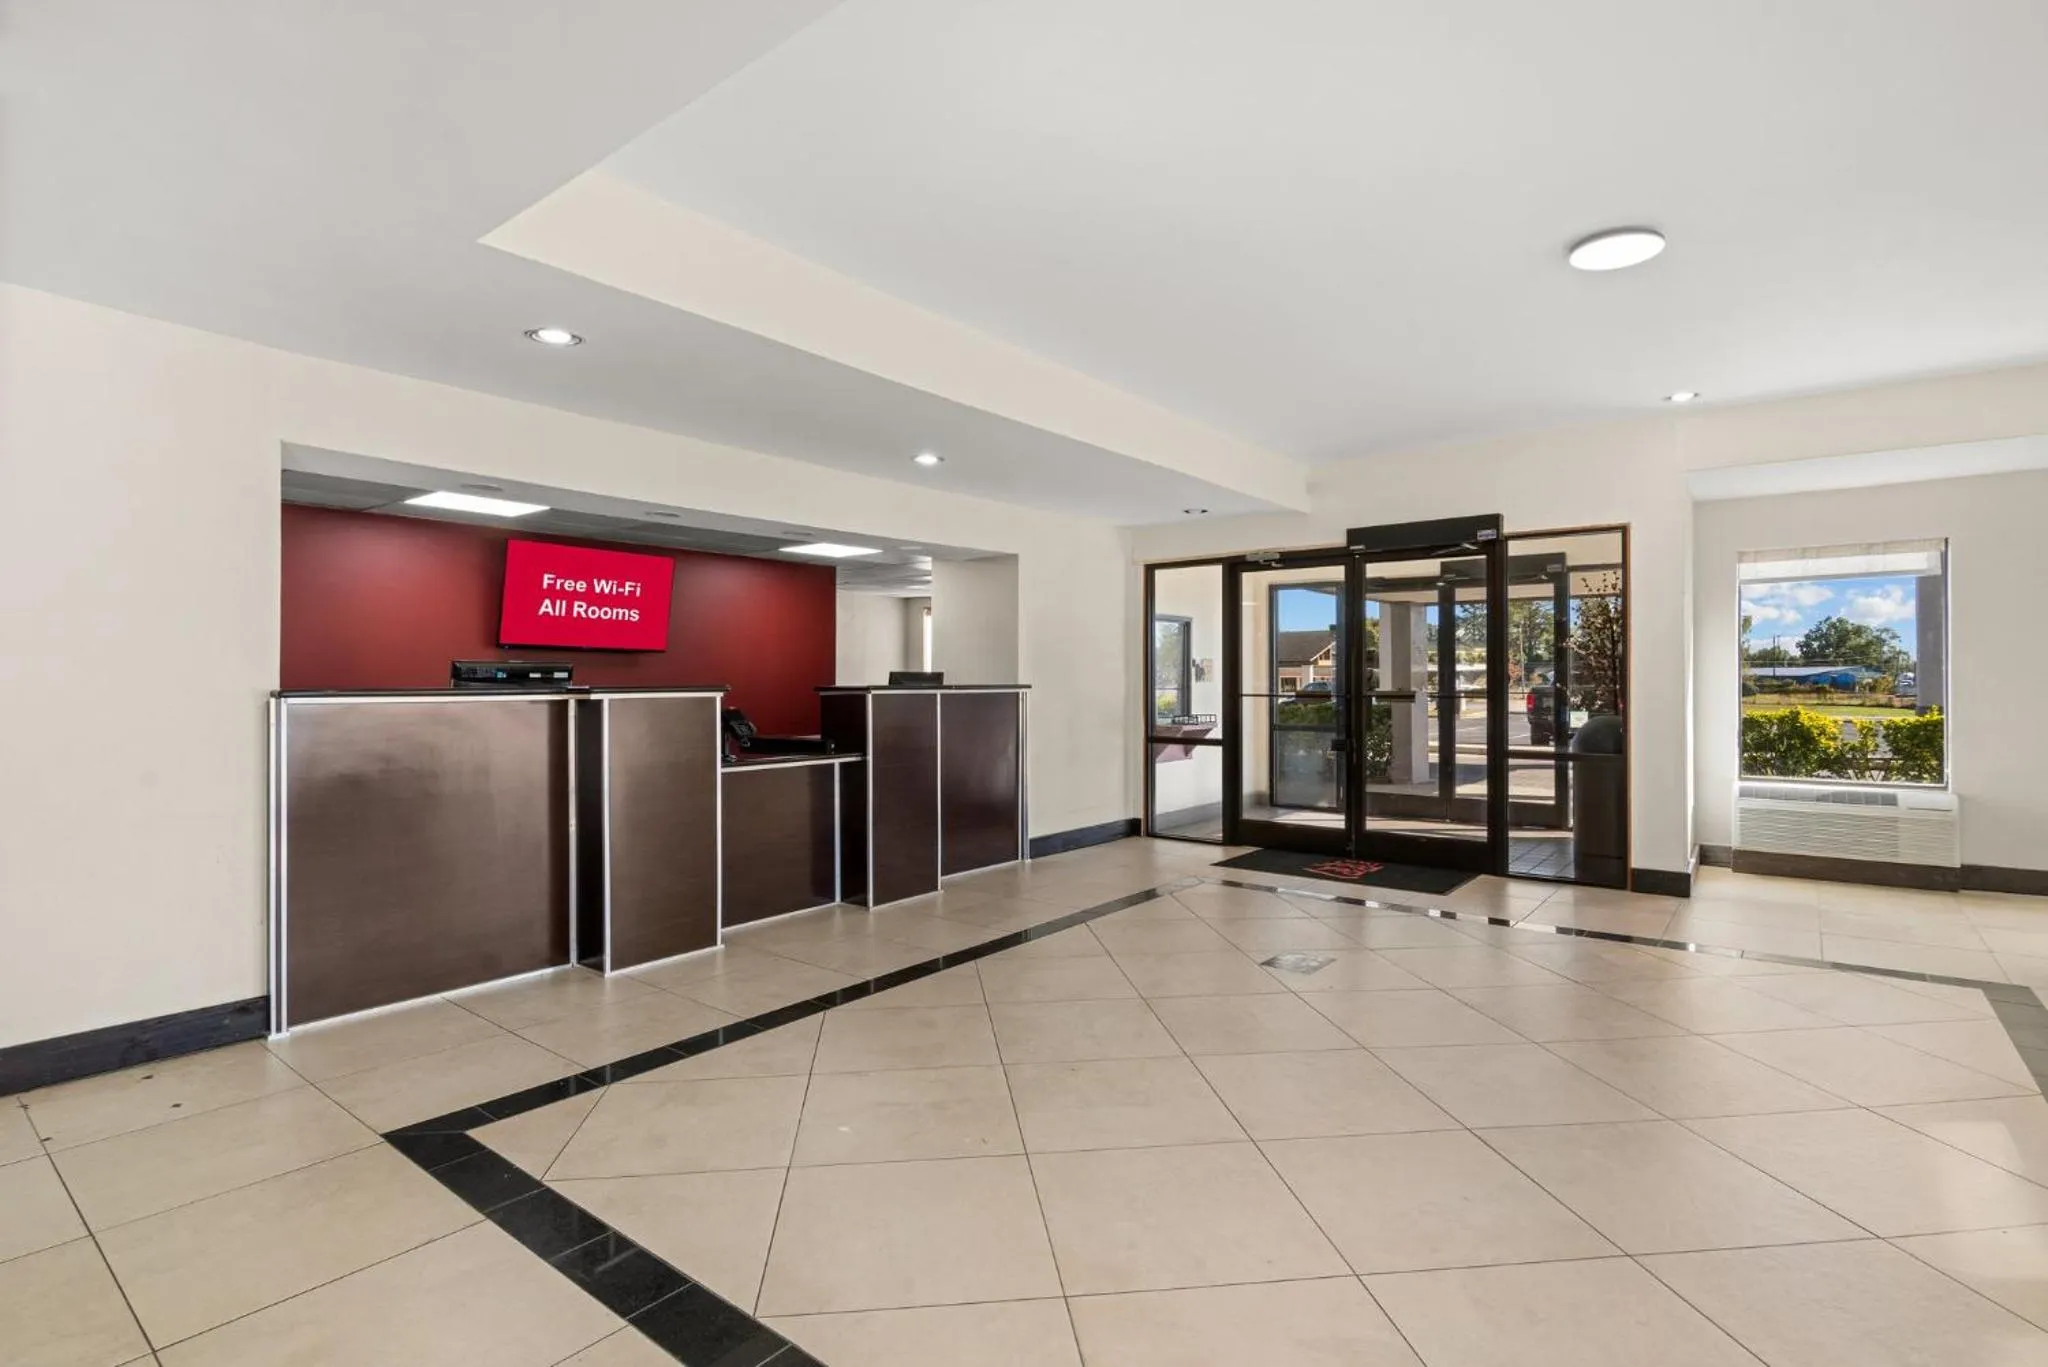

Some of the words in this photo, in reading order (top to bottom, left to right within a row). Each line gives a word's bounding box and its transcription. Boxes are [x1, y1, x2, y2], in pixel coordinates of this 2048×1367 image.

[542, 573, 587, 592] Free
[593, 578, 641, 597] Wi-Fi
[538, 598, 566, 617] All
[572, 601, 640, 621] Rooms
